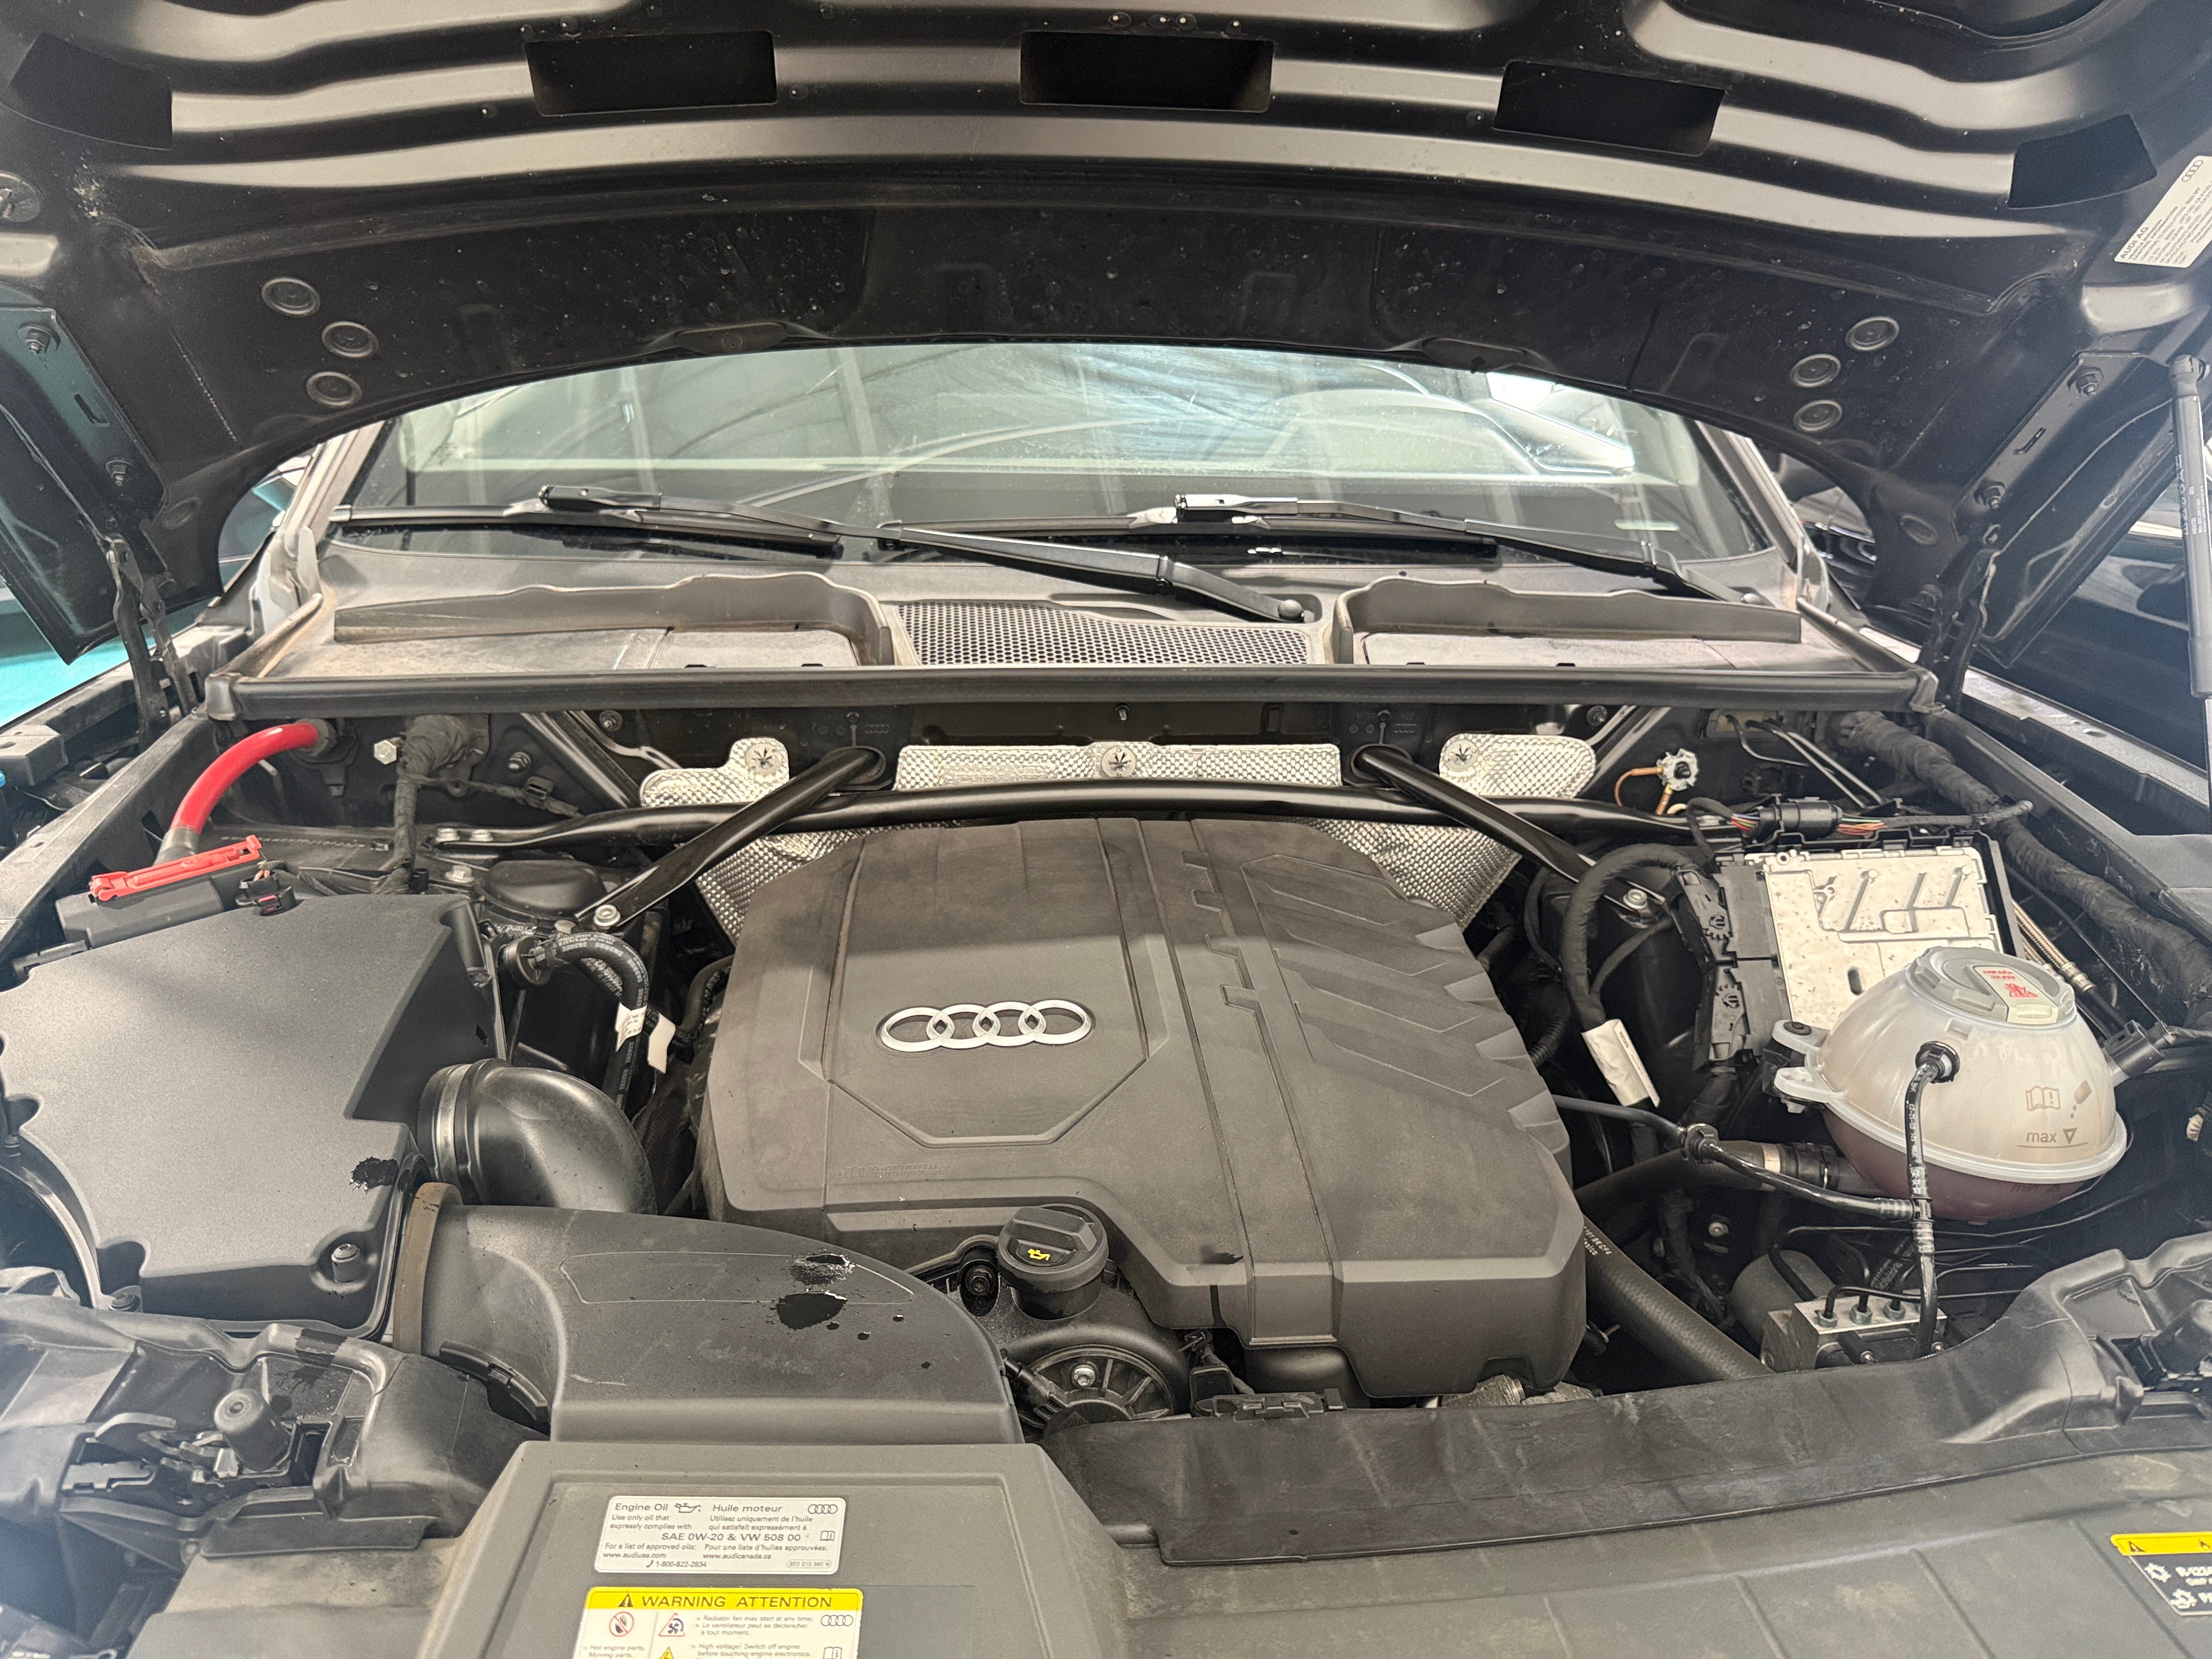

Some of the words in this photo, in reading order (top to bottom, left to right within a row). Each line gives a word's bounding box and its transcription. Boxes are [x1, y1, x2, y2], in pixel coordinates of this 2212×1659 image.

[2120, 240, 2138, 259] AUDI
[2137, 227, 2149, 239] AG
[2026, 1132, 2057, 1143] max
[614, 1503, 650, 1512] Engine
[654, 1503, 669, 1511] Oil
[661, 1532, 685, 1541] SAE
[687, 1533, 724, 1541] 0W-20
[641, 1596, 726, 1607] WARNING
[736, 1596, 832, 1608] ATTENTION
